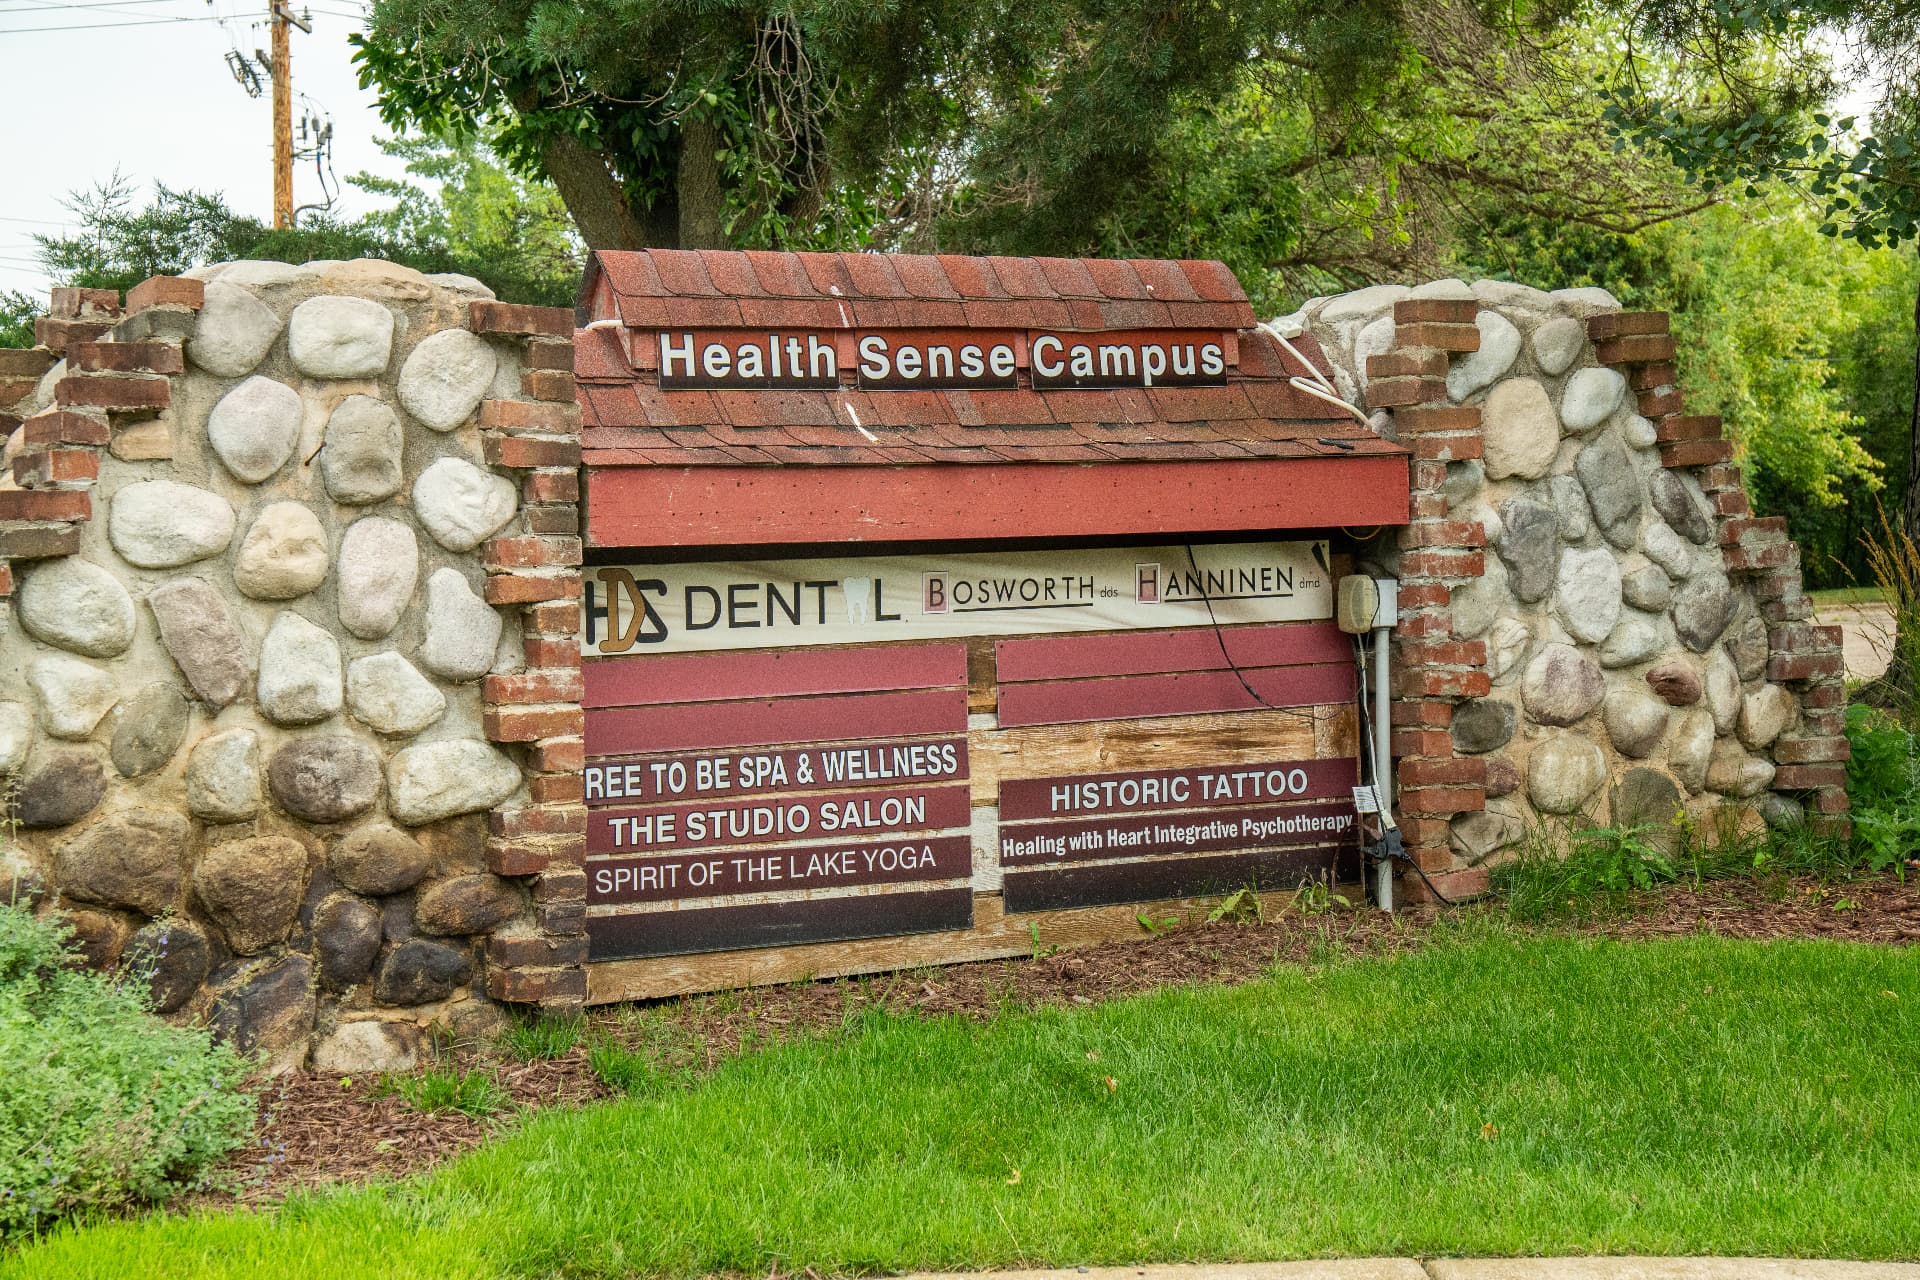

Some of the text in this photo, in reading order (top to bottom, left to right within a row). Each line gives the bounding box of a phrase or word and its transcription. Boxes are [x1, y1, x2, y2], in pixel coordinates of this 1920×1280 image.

[661, 332, 1225, 387] Health Sense Campus
[929, 576, 1094, 607] BOSWORTH
[1100, 586, 1119, 598] dds
[1139, 567, 1293, 597] HANNINEN
[1299, 576, 1321, 589] dmd
[650, 761, 687, 794] TO
[697, 757, 731, 791] BE
[739, 754, 788, 788] SPA
[797, 753, 813, 784] &
[822, 743, 957, 783] WELLNESS
[1051, 768, 1307, 812] HISTORIC TATTOO
[608, 796, 925, 847] THE STUDIO SALON
[1002, 813, 1353, 857] Healing with Heart Integrative Psychotherapy
[596, 845, 936, 894] SPIRIT OF THE LAKE YOGA
